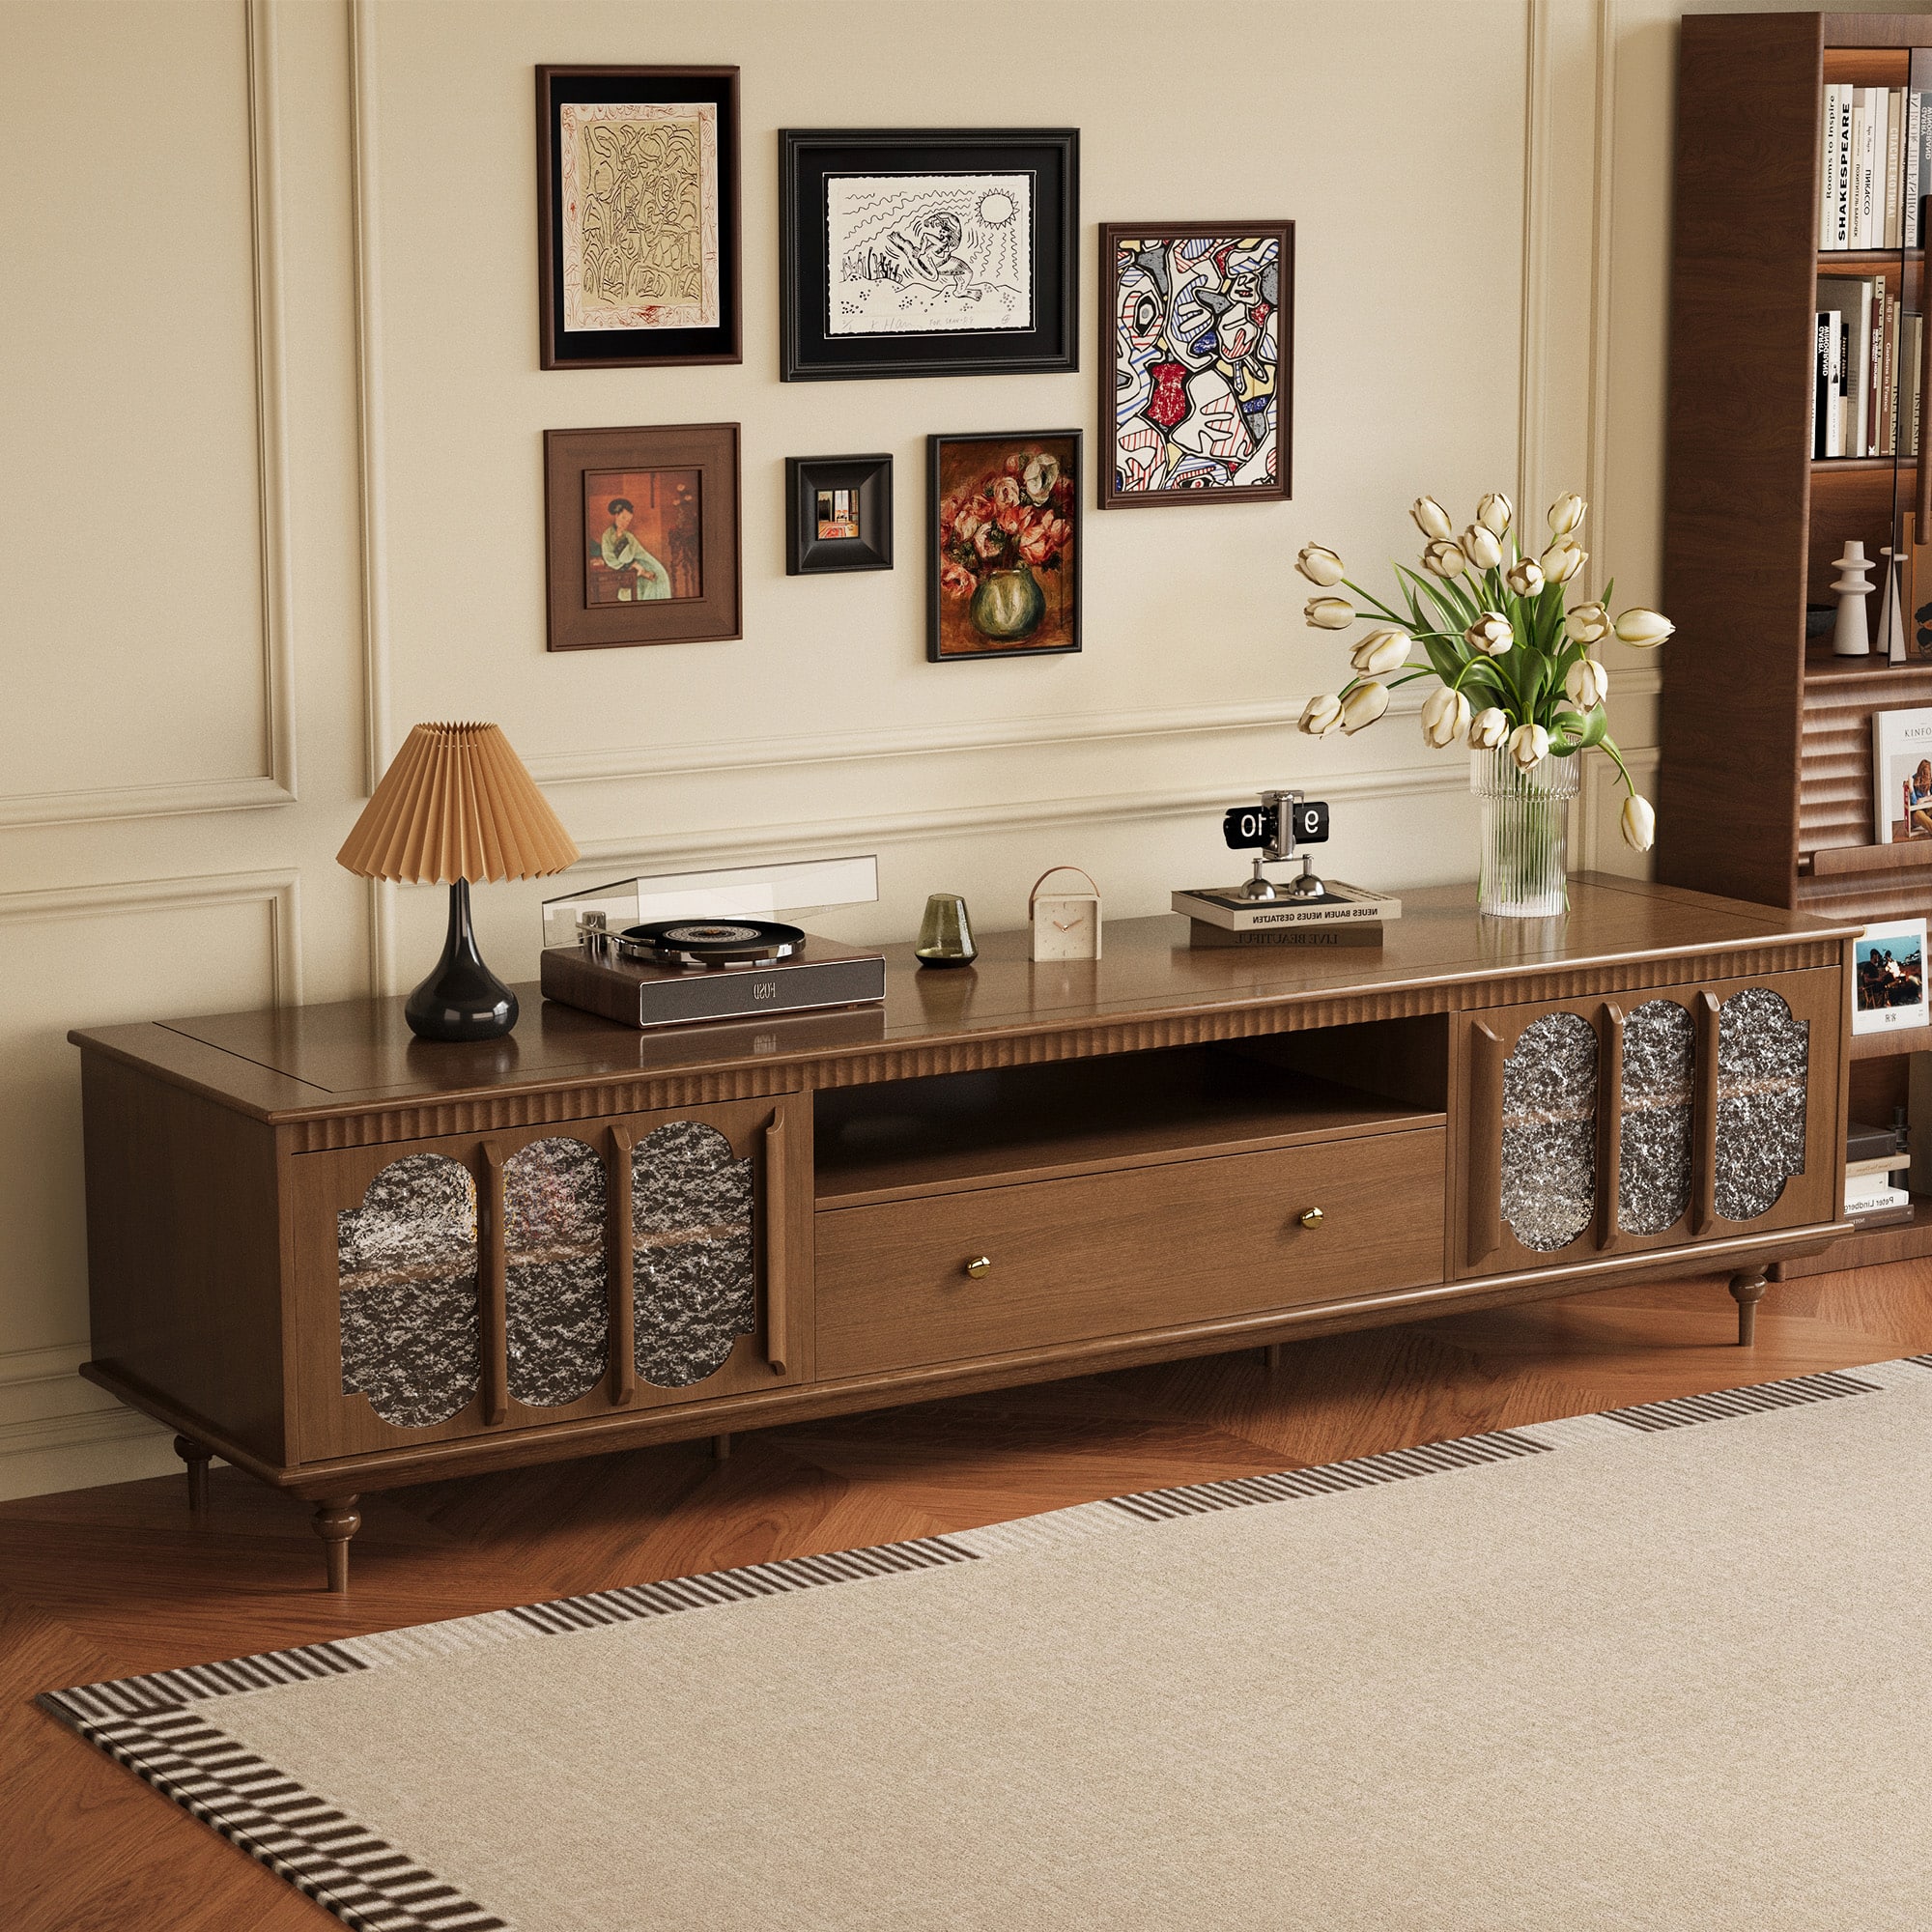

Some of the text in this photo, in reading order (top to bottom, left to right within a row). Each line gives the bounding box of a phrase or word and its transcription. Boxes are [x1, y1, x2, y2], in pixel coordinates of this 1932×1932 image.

[1828, 141, 1833, 154] to
[1838, 103, 1850, 242] SHAKESPEARE
[1863, 169, 1872, 215] ПИКАССО
[1884, 376, 1890, 384] in
